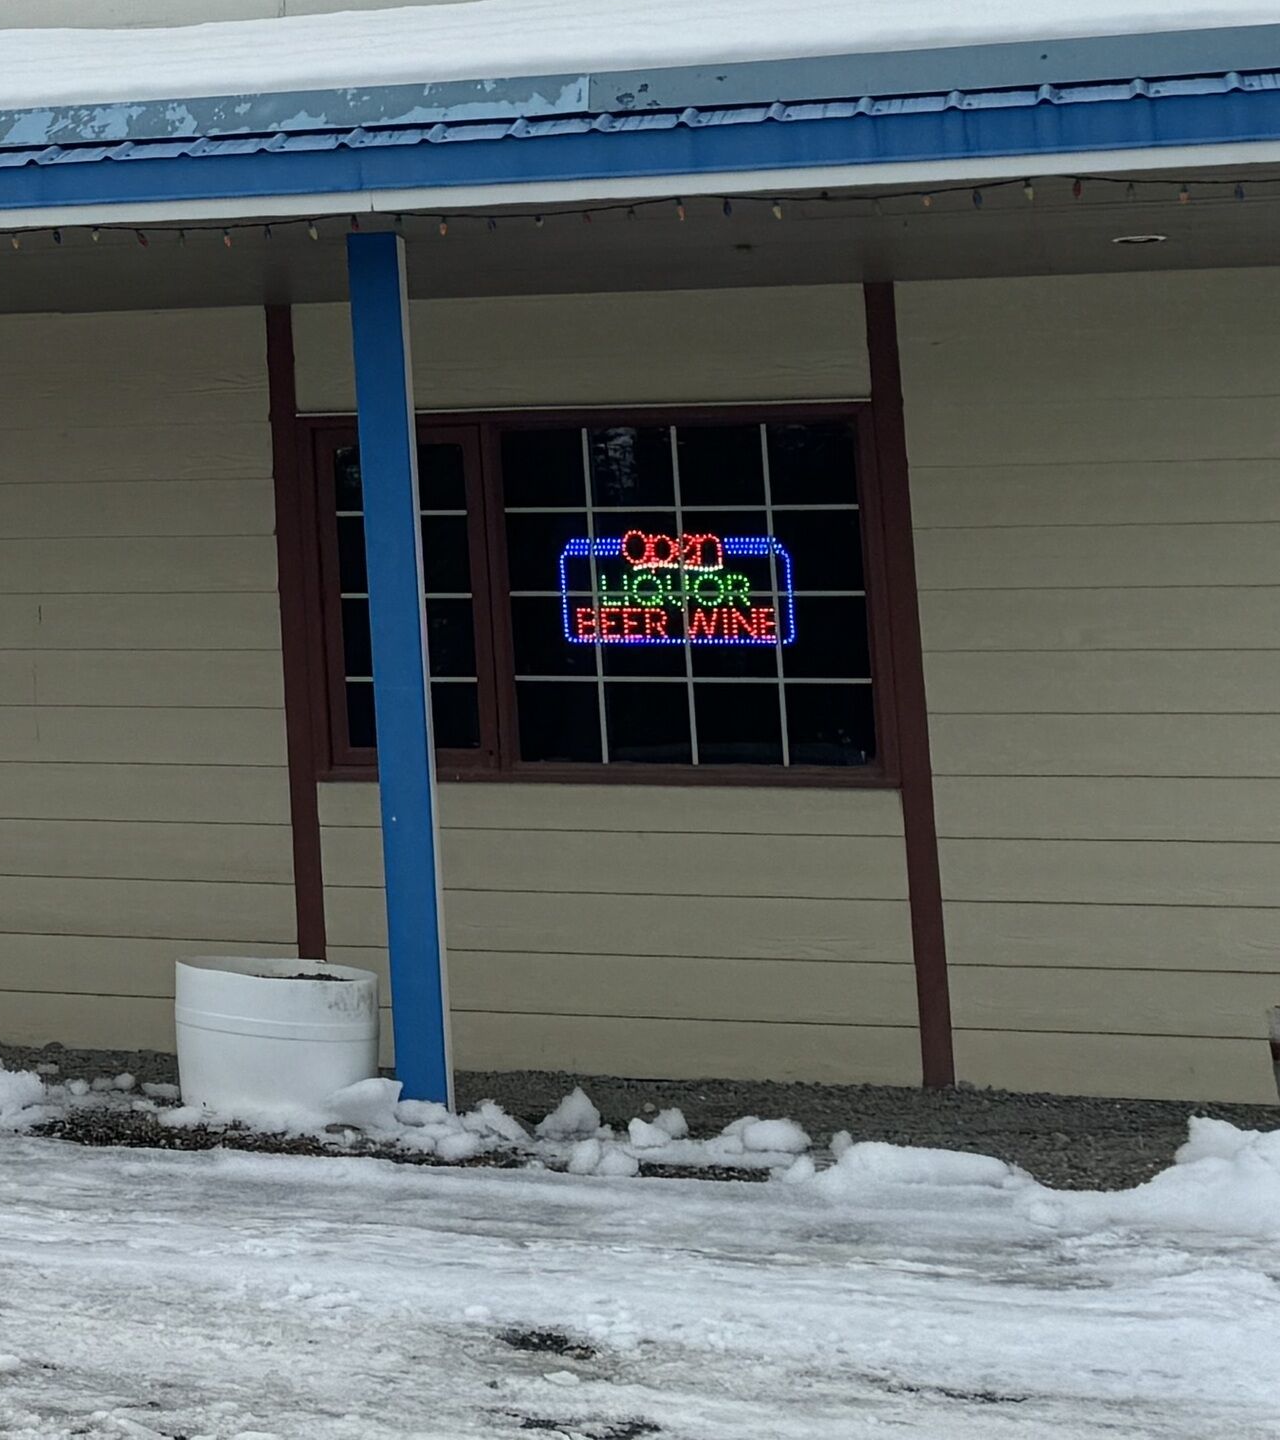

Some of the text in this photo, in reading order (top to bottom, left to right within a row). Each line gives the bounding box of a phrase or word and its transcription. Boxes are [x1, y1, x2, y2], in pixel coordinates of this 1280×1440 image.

[600, 573, 752, 610] LIQUOR
[576, 607, 778, 642] BEER WINE
